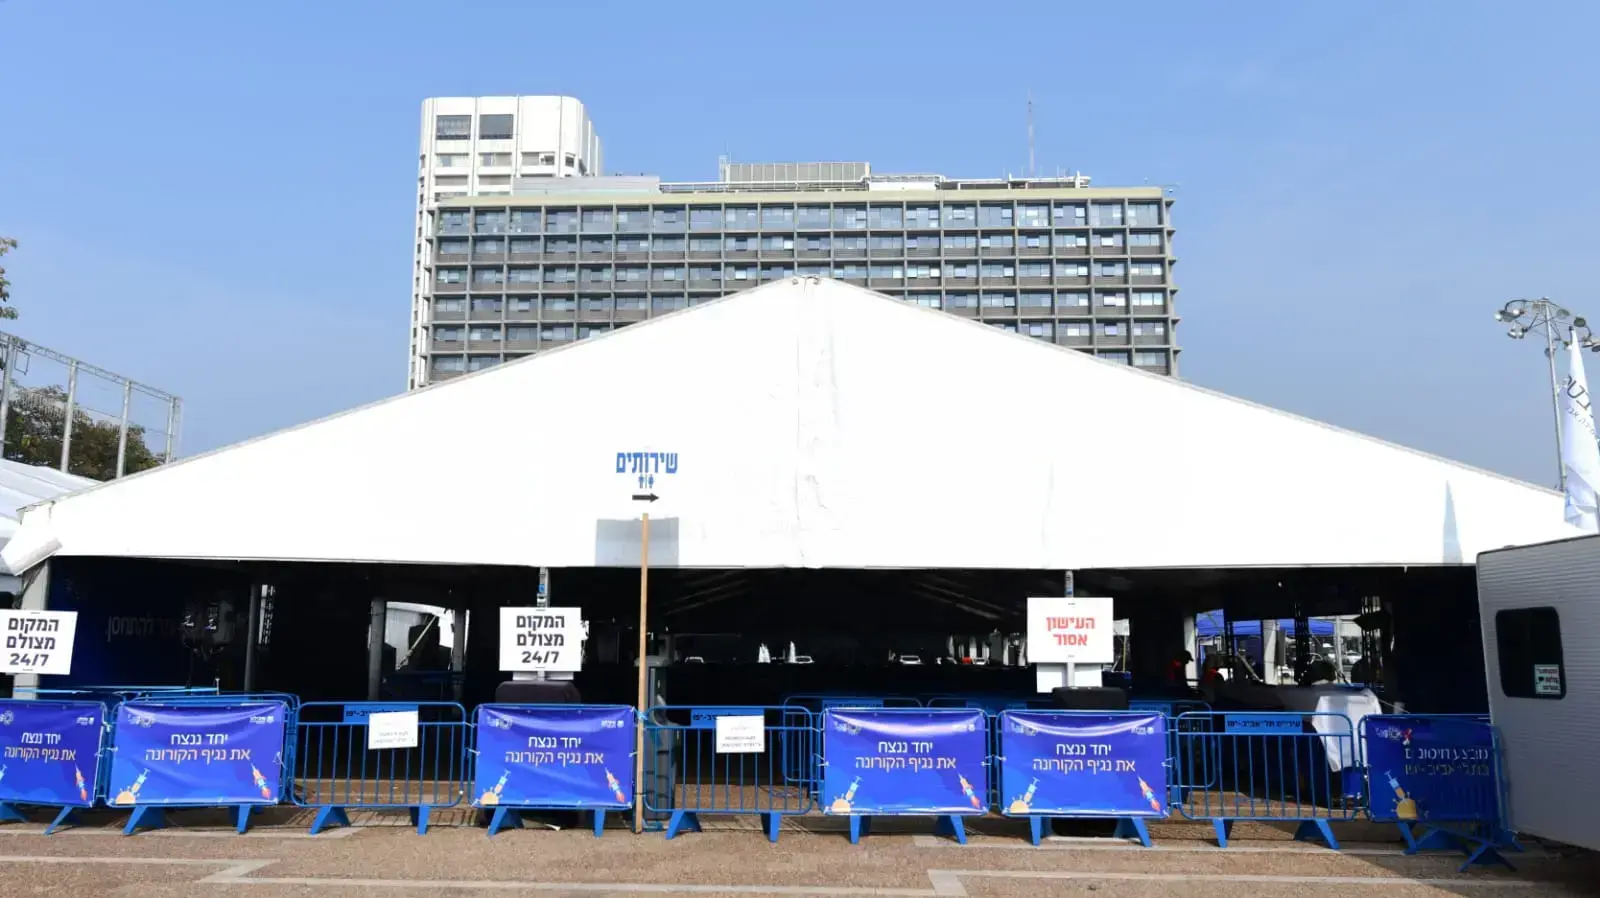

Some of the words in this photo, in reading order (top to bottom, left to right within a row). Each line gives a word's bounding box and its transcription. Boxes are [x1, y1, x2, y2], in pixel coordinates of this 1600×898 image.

[616, 452, 678, 473] שירותים
[8, 617, 60, 634] המקום
[516, 615, 565, 633] המקום
[1046, 616, 1095, 632] העישון
[6, 633, 56, 650] מצולם
[516, 630, 565, 647] מצולם
[1053, 633, 1088, 647] אסור
[9, 652, 49, 666] 24/7
[521, 651, 560, 664] 24/7
[21, 732, 43, 744] ננצח
[44, 733, 61, 744] יחד
[171, 733, 202, 746] ננצח
[205, 733, 229, 745] יחד
[528, 736, 557, 748] ננצח
[559, 737, 582, 749] יחד
[878, 741, 908, 753] ננצח
[911, 741, 933, 753] יחד
[1056, 743, 1086, 755] ננצח
[1089, 744, 1112, 756] יחד
[4, 746, 40, 763] הקורונה
[41, 748, 60, 764] נגיף
[61, 749, 76, 761] את
[145, 749, 198, 765] הקורונה
[201, 749, 227, 765] נגיף
[230, 749, 251, 760] את
[505, 751, 554, 767] הקורונה
[557, 752, 581, 768] נגיף
[584, 753, 604, 764] את
[855, 757, 905, 773] הקורונה
[908, 757, 933, 773] נגיף
[936, 757, 956, 769] את
[1033, 758, 1083, 775] הקורונה
[1087, 759, 1112, 775] נגיף
[1115, 760, 1136, 772] את
